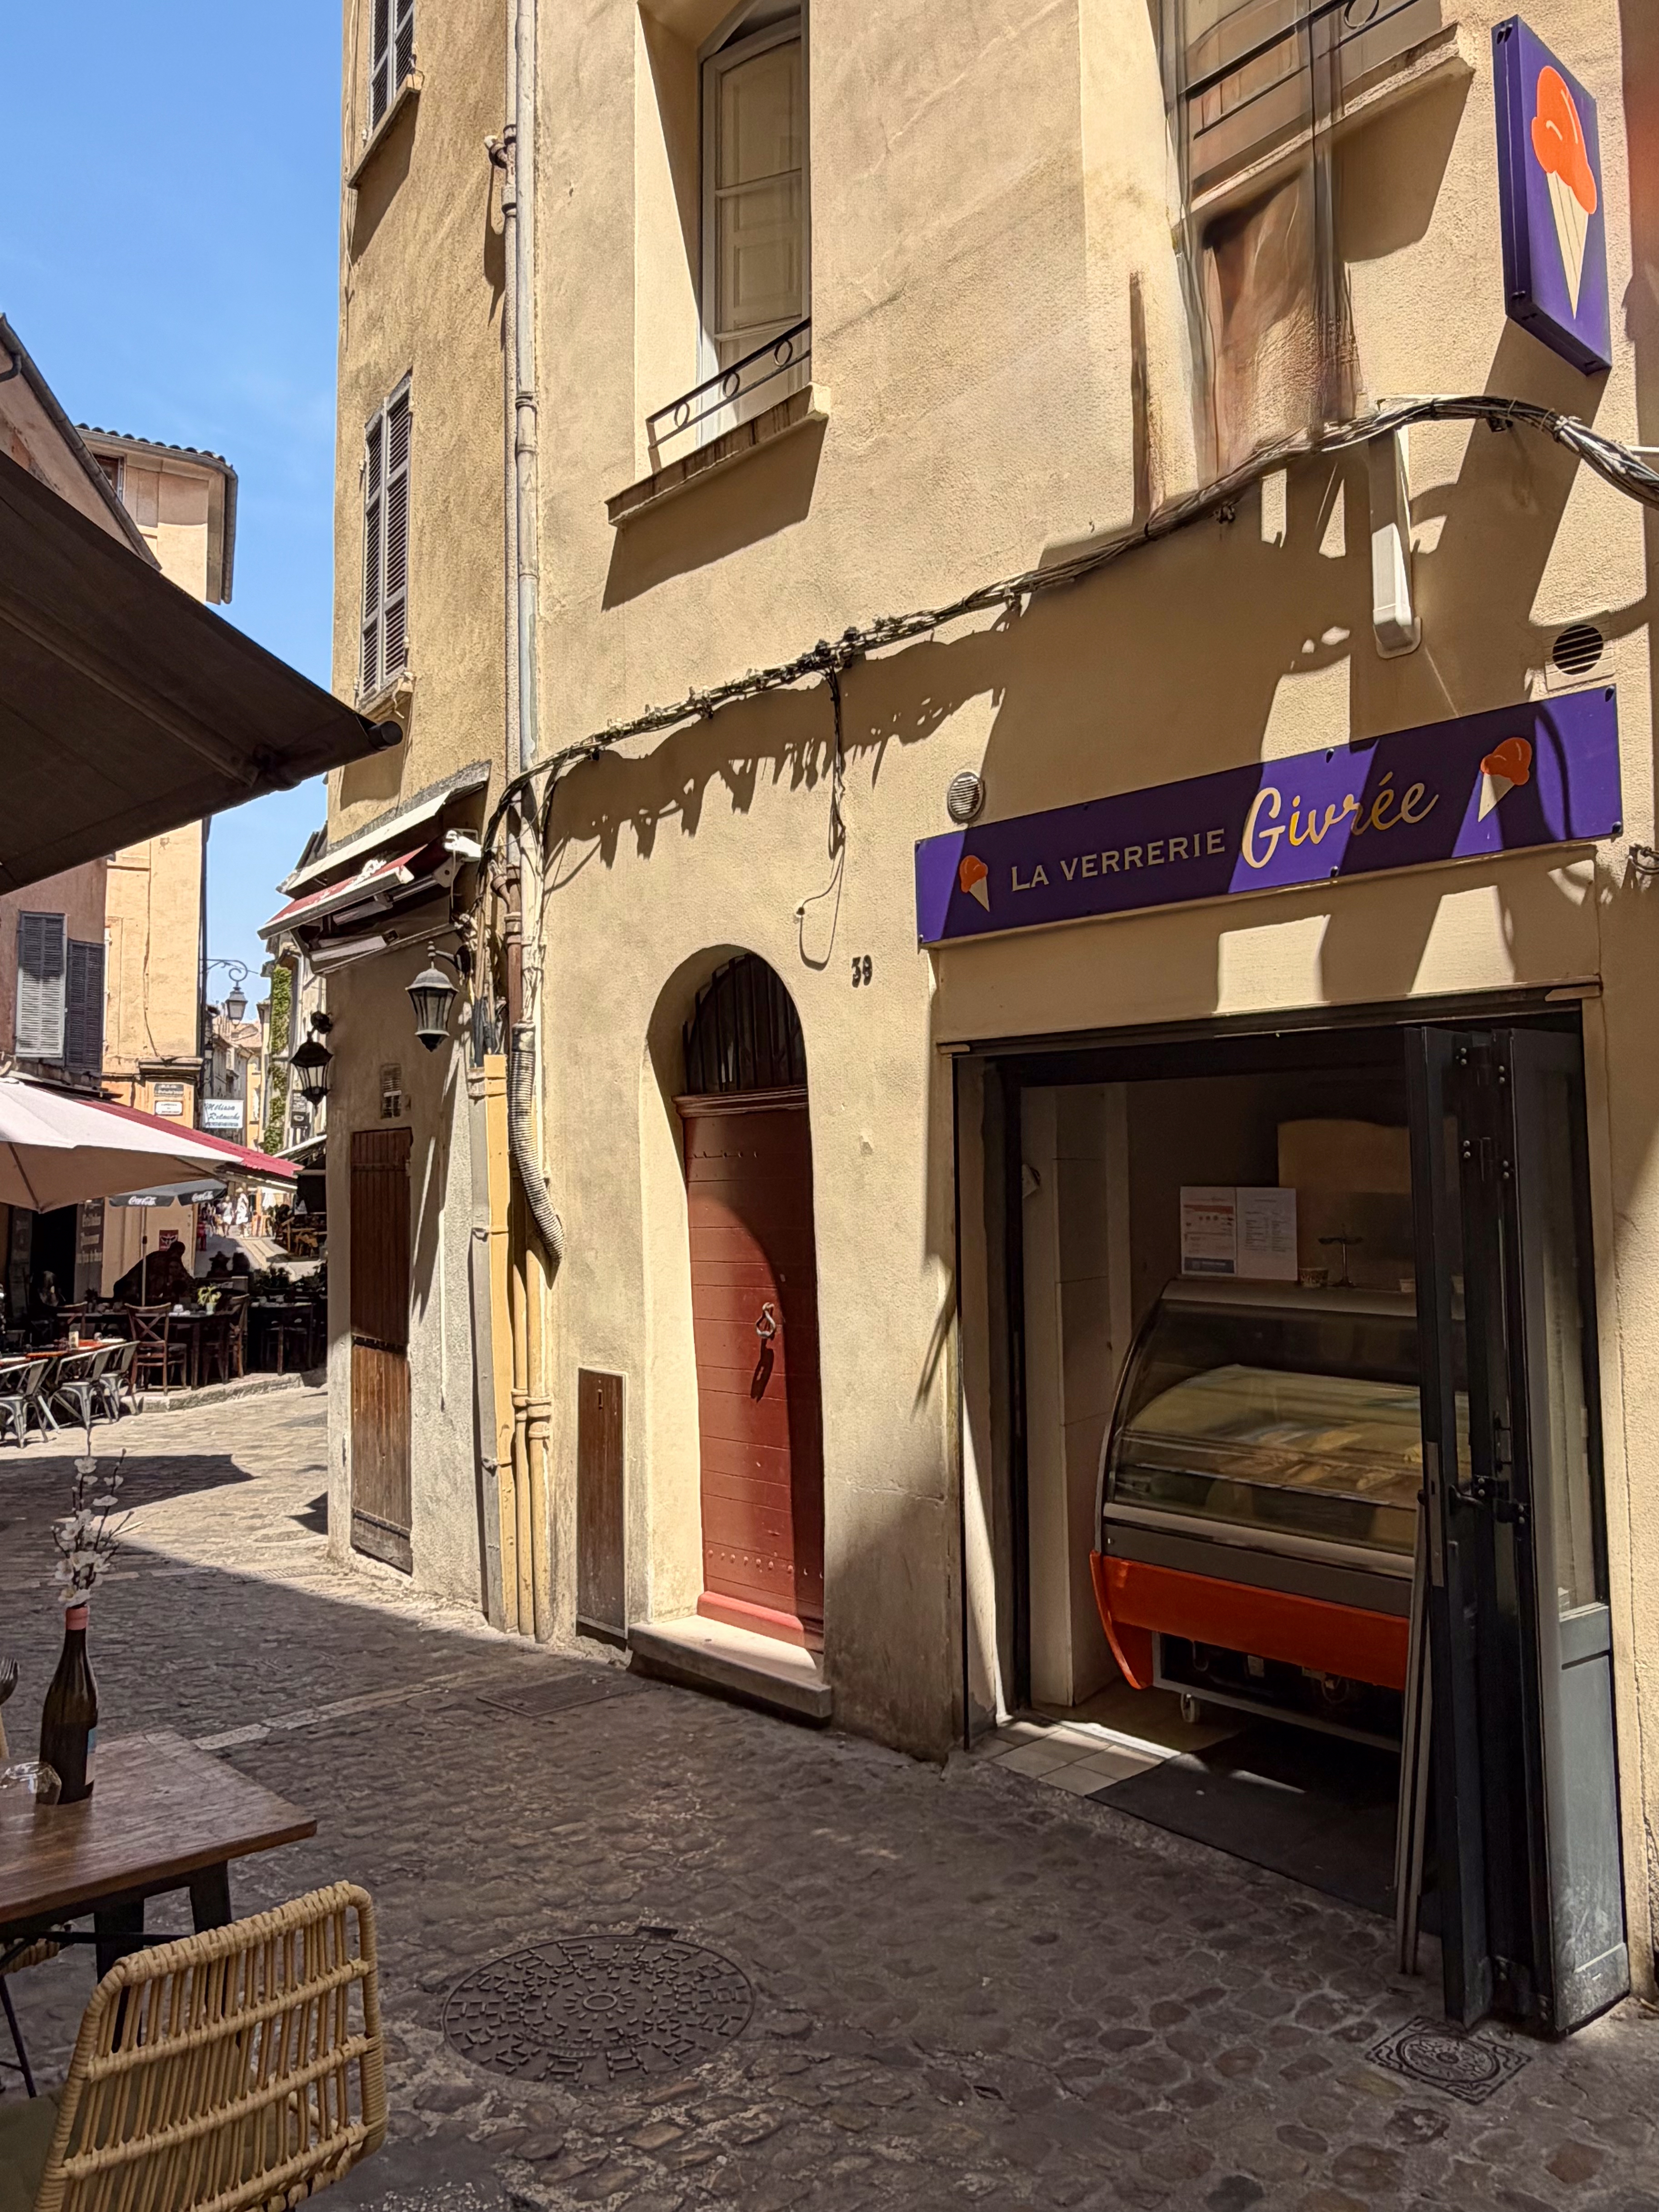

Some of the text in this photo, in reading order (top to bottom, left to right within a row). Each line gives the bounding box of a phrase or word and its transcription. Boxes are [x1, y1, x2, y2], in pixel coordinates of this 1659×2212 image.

[1011, 771, 1439, 891] LA VERRERIE Givrée
